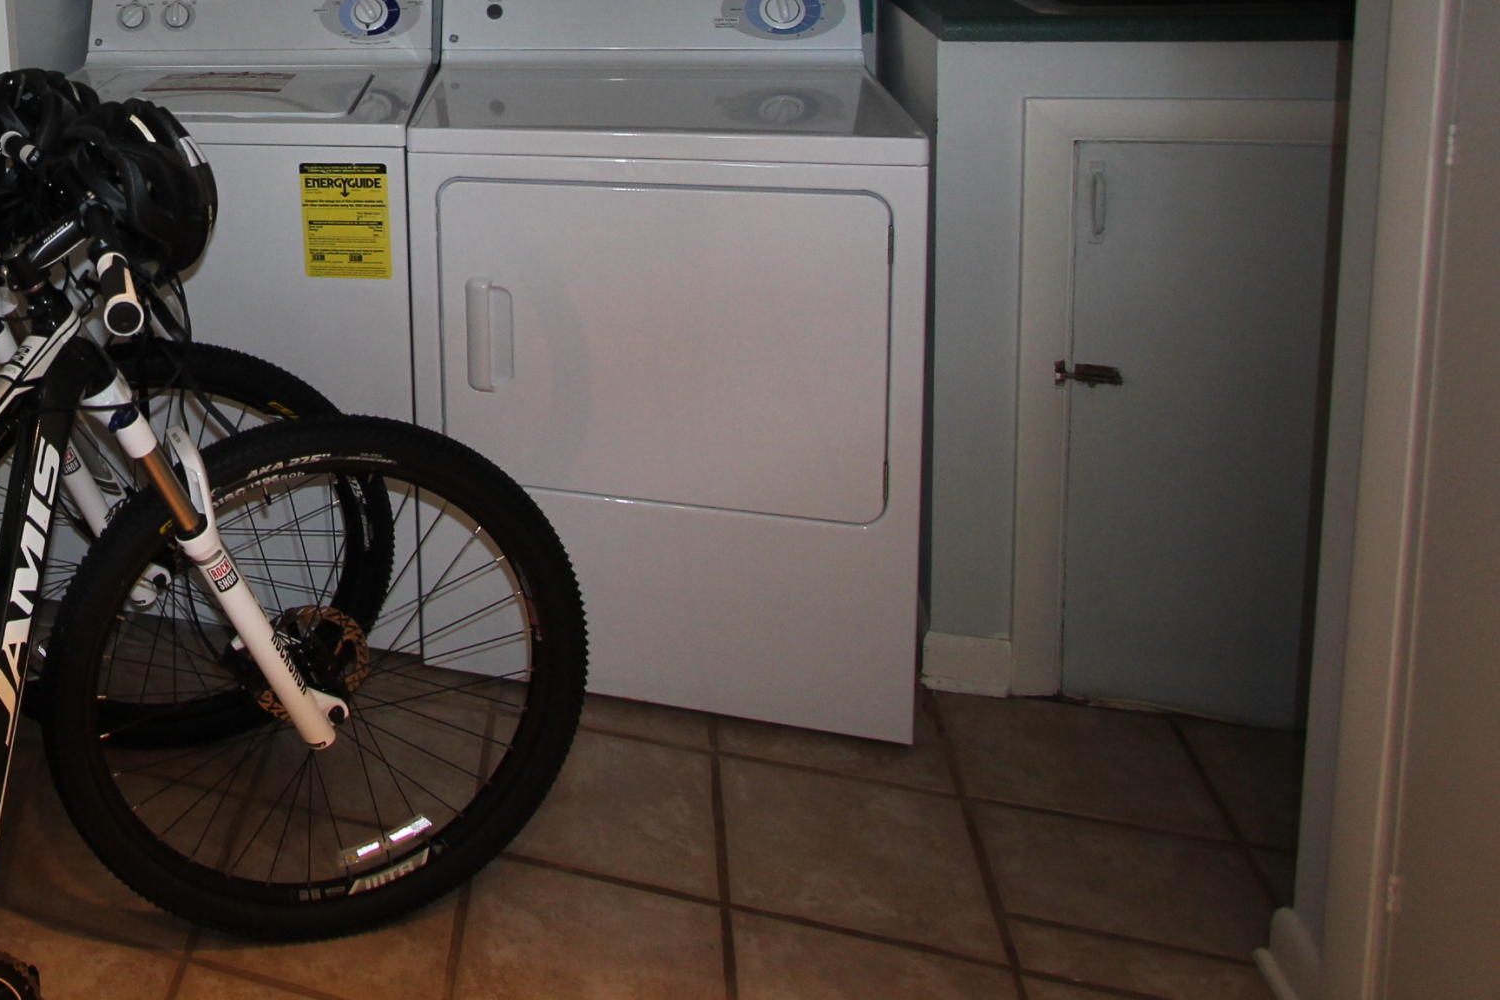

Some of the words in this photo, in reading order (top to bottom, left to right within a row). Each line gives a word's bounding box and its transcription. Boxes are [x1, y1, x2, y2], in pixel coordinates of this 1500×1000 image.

[304, 177, 382, 190] ENERGYGUIDE
[210, 561, 231, 580] ROCK
[218, 572, 239, 591] SHOX
